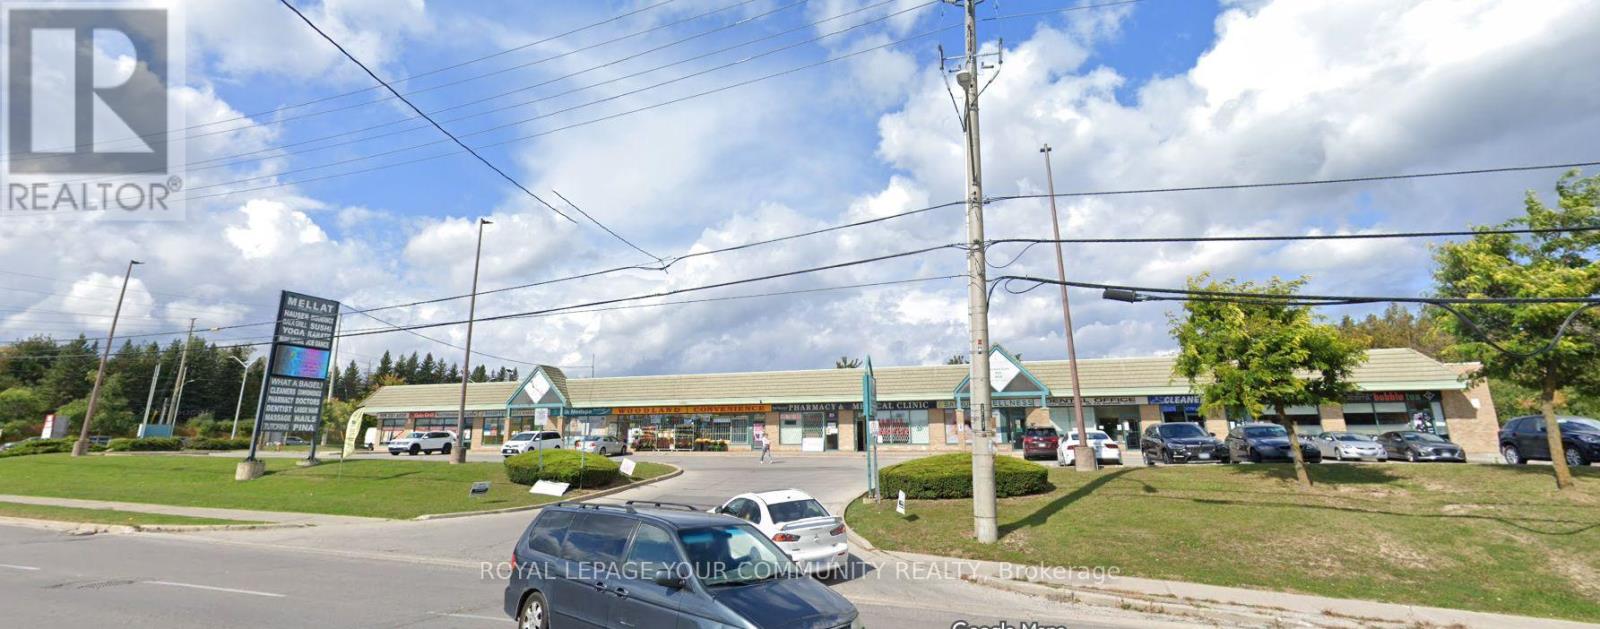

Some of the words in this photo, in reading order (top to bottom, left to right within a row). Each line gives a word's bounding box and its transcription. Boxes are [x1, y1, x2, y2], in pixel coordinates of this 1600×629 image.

[287, 296, 334, 313] MELLAT
[282, 326, 305, 337] YOGA
[310, 322, 332, 333] SUSHI
[271, 378, 292, 386] WHAT
[295, 397, 320, 406] DOCTORS
[990, 400, 1034, 408] ELLNESS
[1164, 395, 1202, 404] CLEANE
[266, 404, 292, 413] DENTIST
[618, 406, 681, 414] WOODLAND
[693, 404, 765, 413] CONVENIENCE
[788, 403, 836, 411] PHARMACY
[852, 401, 895, 410] MECAL
[896, 401, 929, 409] CLINIC
[264, 413, 291, 422] MASSAGE
[294, 415, 317, 423] NAILS
[293, 423, 314, 432] PINA
